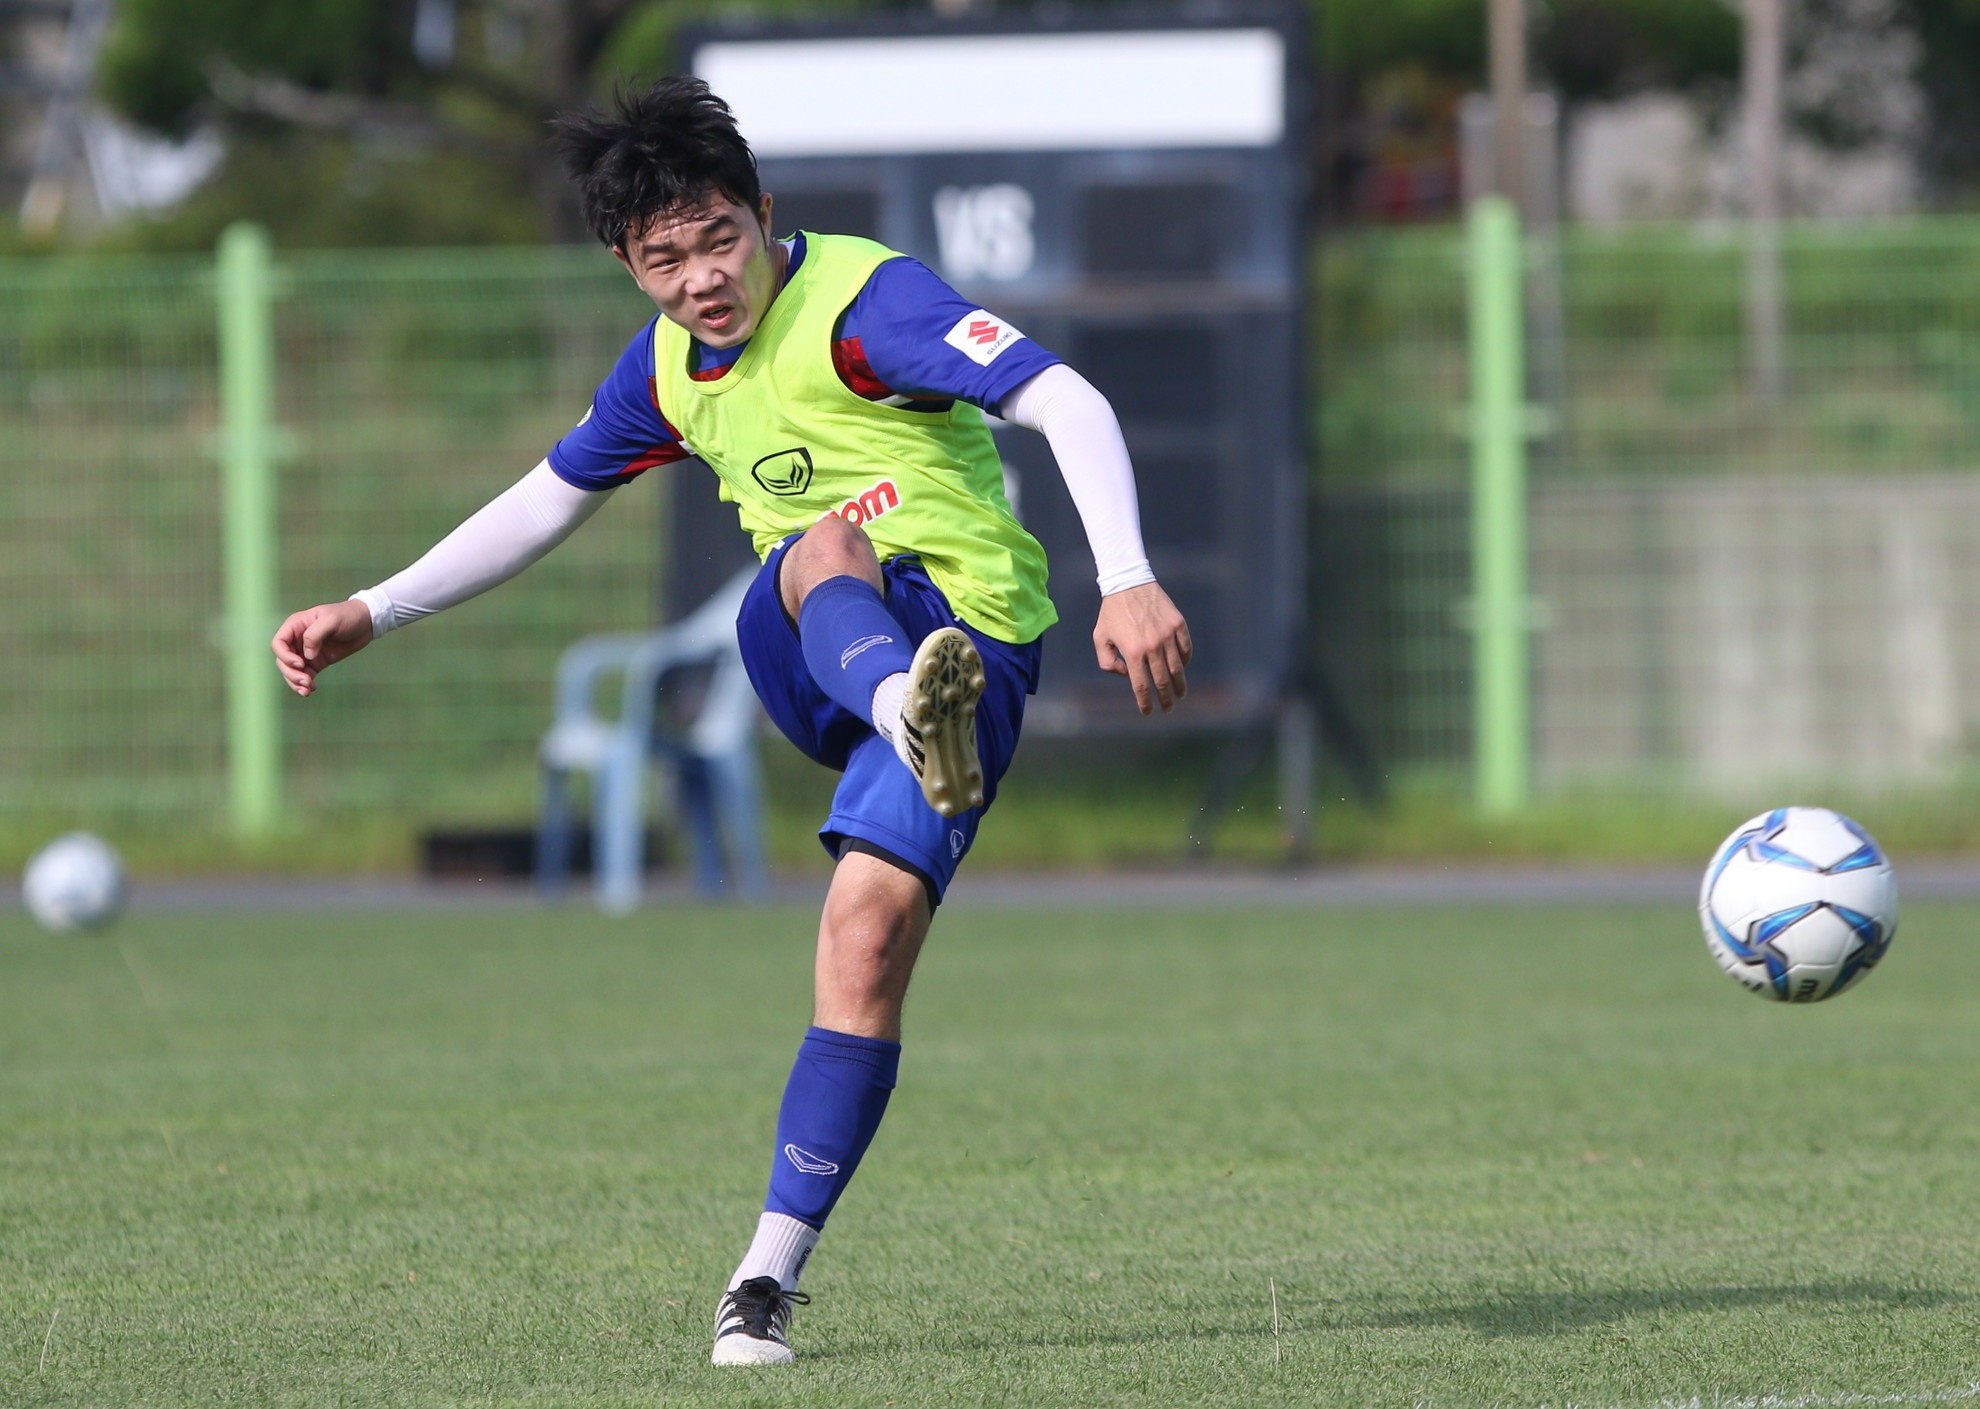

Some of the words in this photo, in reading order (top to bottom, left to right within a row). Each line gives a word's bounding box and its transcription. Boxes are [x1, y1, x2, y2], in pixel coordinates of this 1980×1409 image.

[933, 184, 1036, 280] VS
[987, 331, 1013, 355] SUZUKI
[823, 481, 899, 527] om
